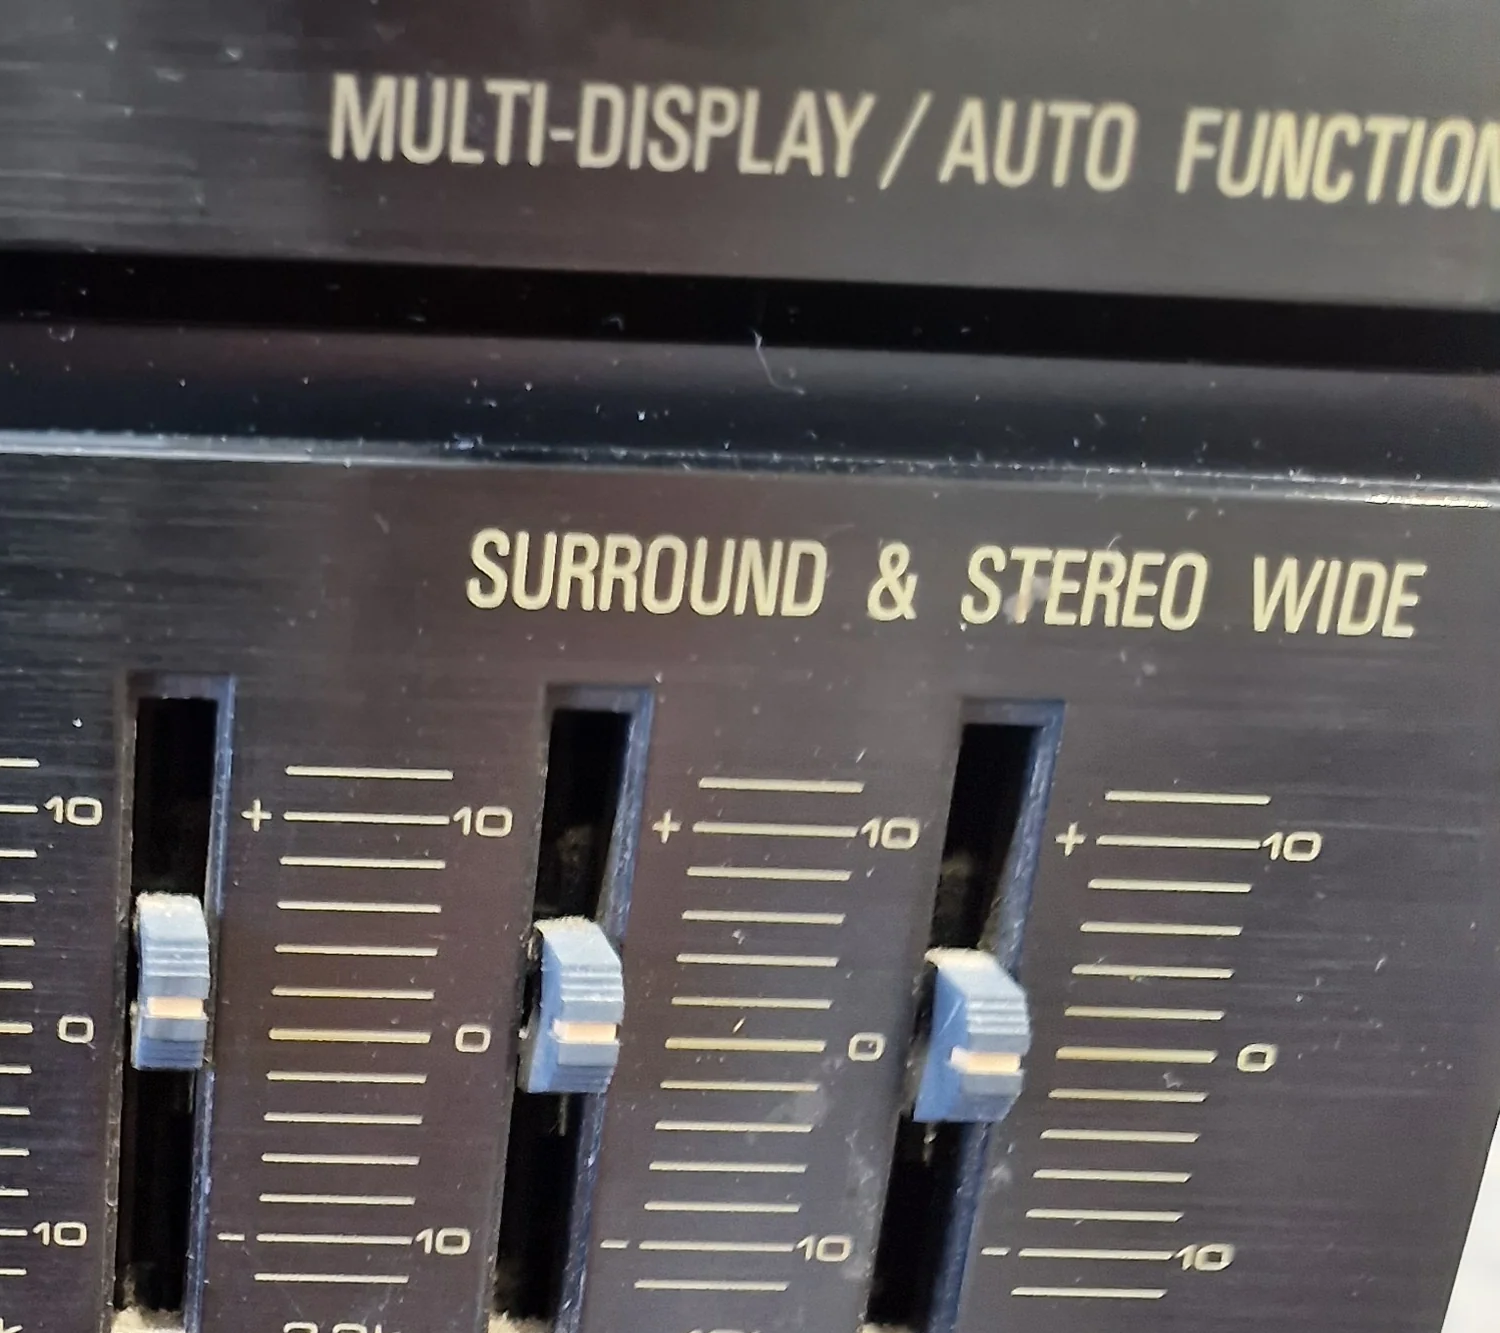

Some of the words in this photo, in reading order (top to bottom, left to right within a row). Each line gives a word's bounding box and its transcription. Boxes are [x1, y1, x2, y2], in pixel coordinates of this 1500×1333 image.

[938, 98, 1138, 192] AUTO
[467, 528, 828, 617] SURROUND
[867, 542, 918, 621] &
[960, 545, 1208, 631] STEREO
[1253, 556, 1428, 638] WIDE
[44, 795, 103, 826] 10
[453, 805, 513, 837] 10
[860, 817, 920, 849] 10
[1262, 831, 1323, 862] 10
[57, 1015, 94, 1044] 0
[455, 1024, 491, 1053] 0
[847, 1032, 885, 1062] 0
[1236, 1043, 1277, 1072] 0
[32, 1221, 88, 1247] 10
[415, 1227, 471, 1255] 10
[796, 1235, 853, 1262] 10
[1174, 1243, 1234, 1271] 10
